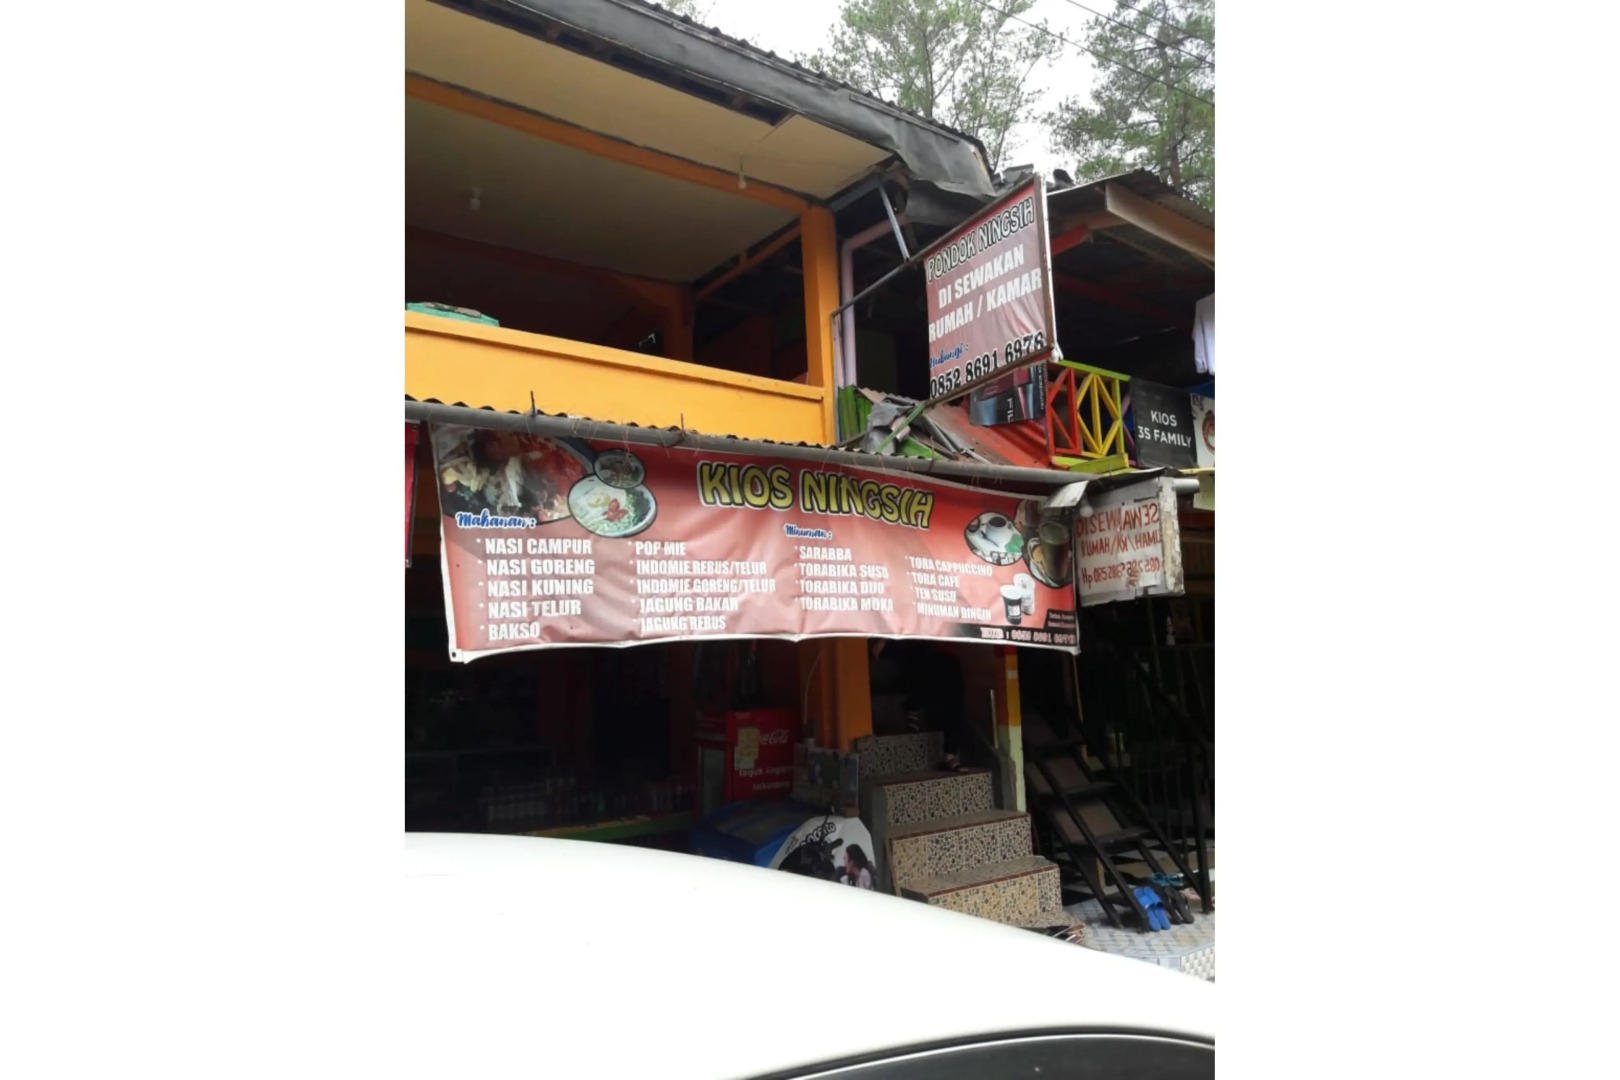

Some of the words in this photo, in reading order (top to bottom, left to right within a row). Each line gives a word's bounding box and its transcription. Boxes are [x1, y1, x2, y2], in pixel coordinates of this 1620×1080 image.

[926, 232, 976, 281] PONDOK
[977, 196, 1034, 249] NINGSIH
[938, 288, 952, 309] DI
[954, 244, 1025, 296] SEWAKAN
[928, 305, 974, 342] RUMAH
[976, 294, 984, 319] /
[986, 268, 1042, 306] KAMAR
[930, 368, 962, 399] 0852
[965, 352, 999, 384] 8691
[1150, 409, 1178, 428] KIOS
[1137, 425, 1152, 440] 3S
[1153, 427, 1192, 449] FAMILY
[696, 460, 795, 512] KIOS
[799, 469, 935, 530] NINGSIH
[485, 538, 523, 555] NASI
[526, 538, 592, 555] CAMPUR
[635, 541, 661, 556] POP
[664, 541, 687, 556] MIE
[799, 545, 852, 561] SARABBA
[487, 559, 527, 576] NASI
[530, 559, 595, 575] GORENG
[636, 559, 690, 575] INDOMIE
[692, 560, 767, 575] REBUS/TELUR
[799, 562, 858, 578] TORABIKA
[859, 564, 889, 579] SUSU
[909, 556, 935, 570] TORA
[934, 559, 993, 577] CAPPUCCINO
[488, 580, 527, 597] NASI
[531, 579, 594, 595] KUNING
[636, 578, 690, 594] INDOMIE
[692, 578, 776, 593] GORENG/TELUR
[799, 579, 858, 594] TORABIKA
[860, 581, 885, 594] DUO
[911, 571, 937, 586] TORA
[938, 574, 960, 588] CAFE
[800, 597, 858, 611] TORABIKA
[860, 597, 894, 612] MOKA
[931, 589, 957, 602] SUSU
[488, 602, 528, 619] NASI
[531, 600, 582, 616] TELUR
[639, 597, 693, 613] JAGUNG
[696, 597, 739, 612] BAKAR
[917, 602, 959, 618] MINUMAN
[960, 606, 992, 620] DINGIN
[488, 623, 541, 641] BAKSO
[640, 616, 688, 633] JAGUNG
[689, 615, 726, 631] REBUS
